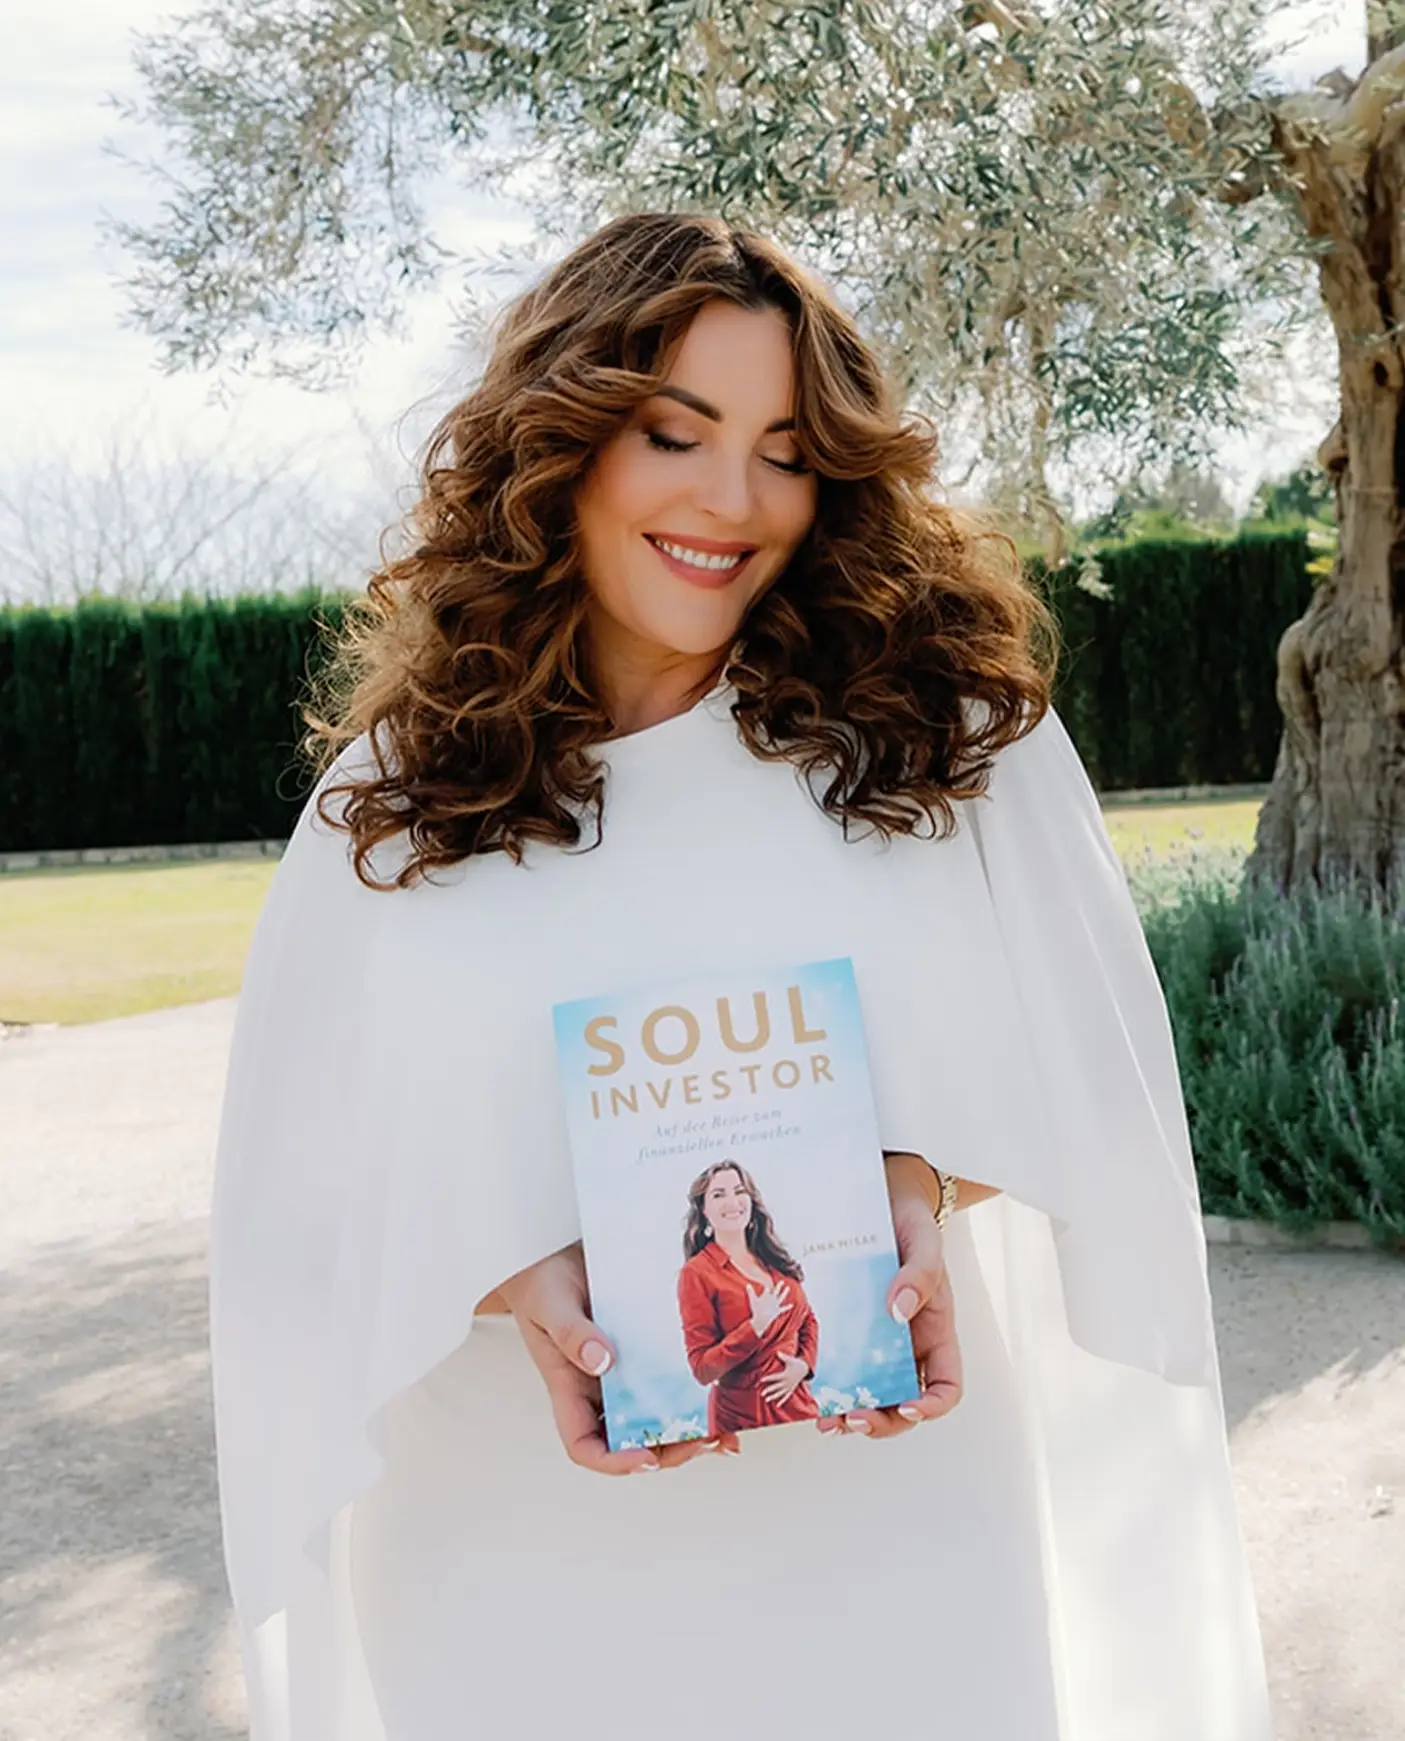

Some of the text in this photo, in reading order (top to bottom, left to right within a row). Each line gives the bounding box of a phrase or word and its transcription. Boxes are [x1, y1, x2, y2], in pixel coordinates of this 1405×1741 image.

[584, 984, 827, 1077] SOUL
[591, 1054, 834, 1119] INVESTOR
[655, 1123, 678, 1139] Auf
[682, 1119, 707, 1134] der
